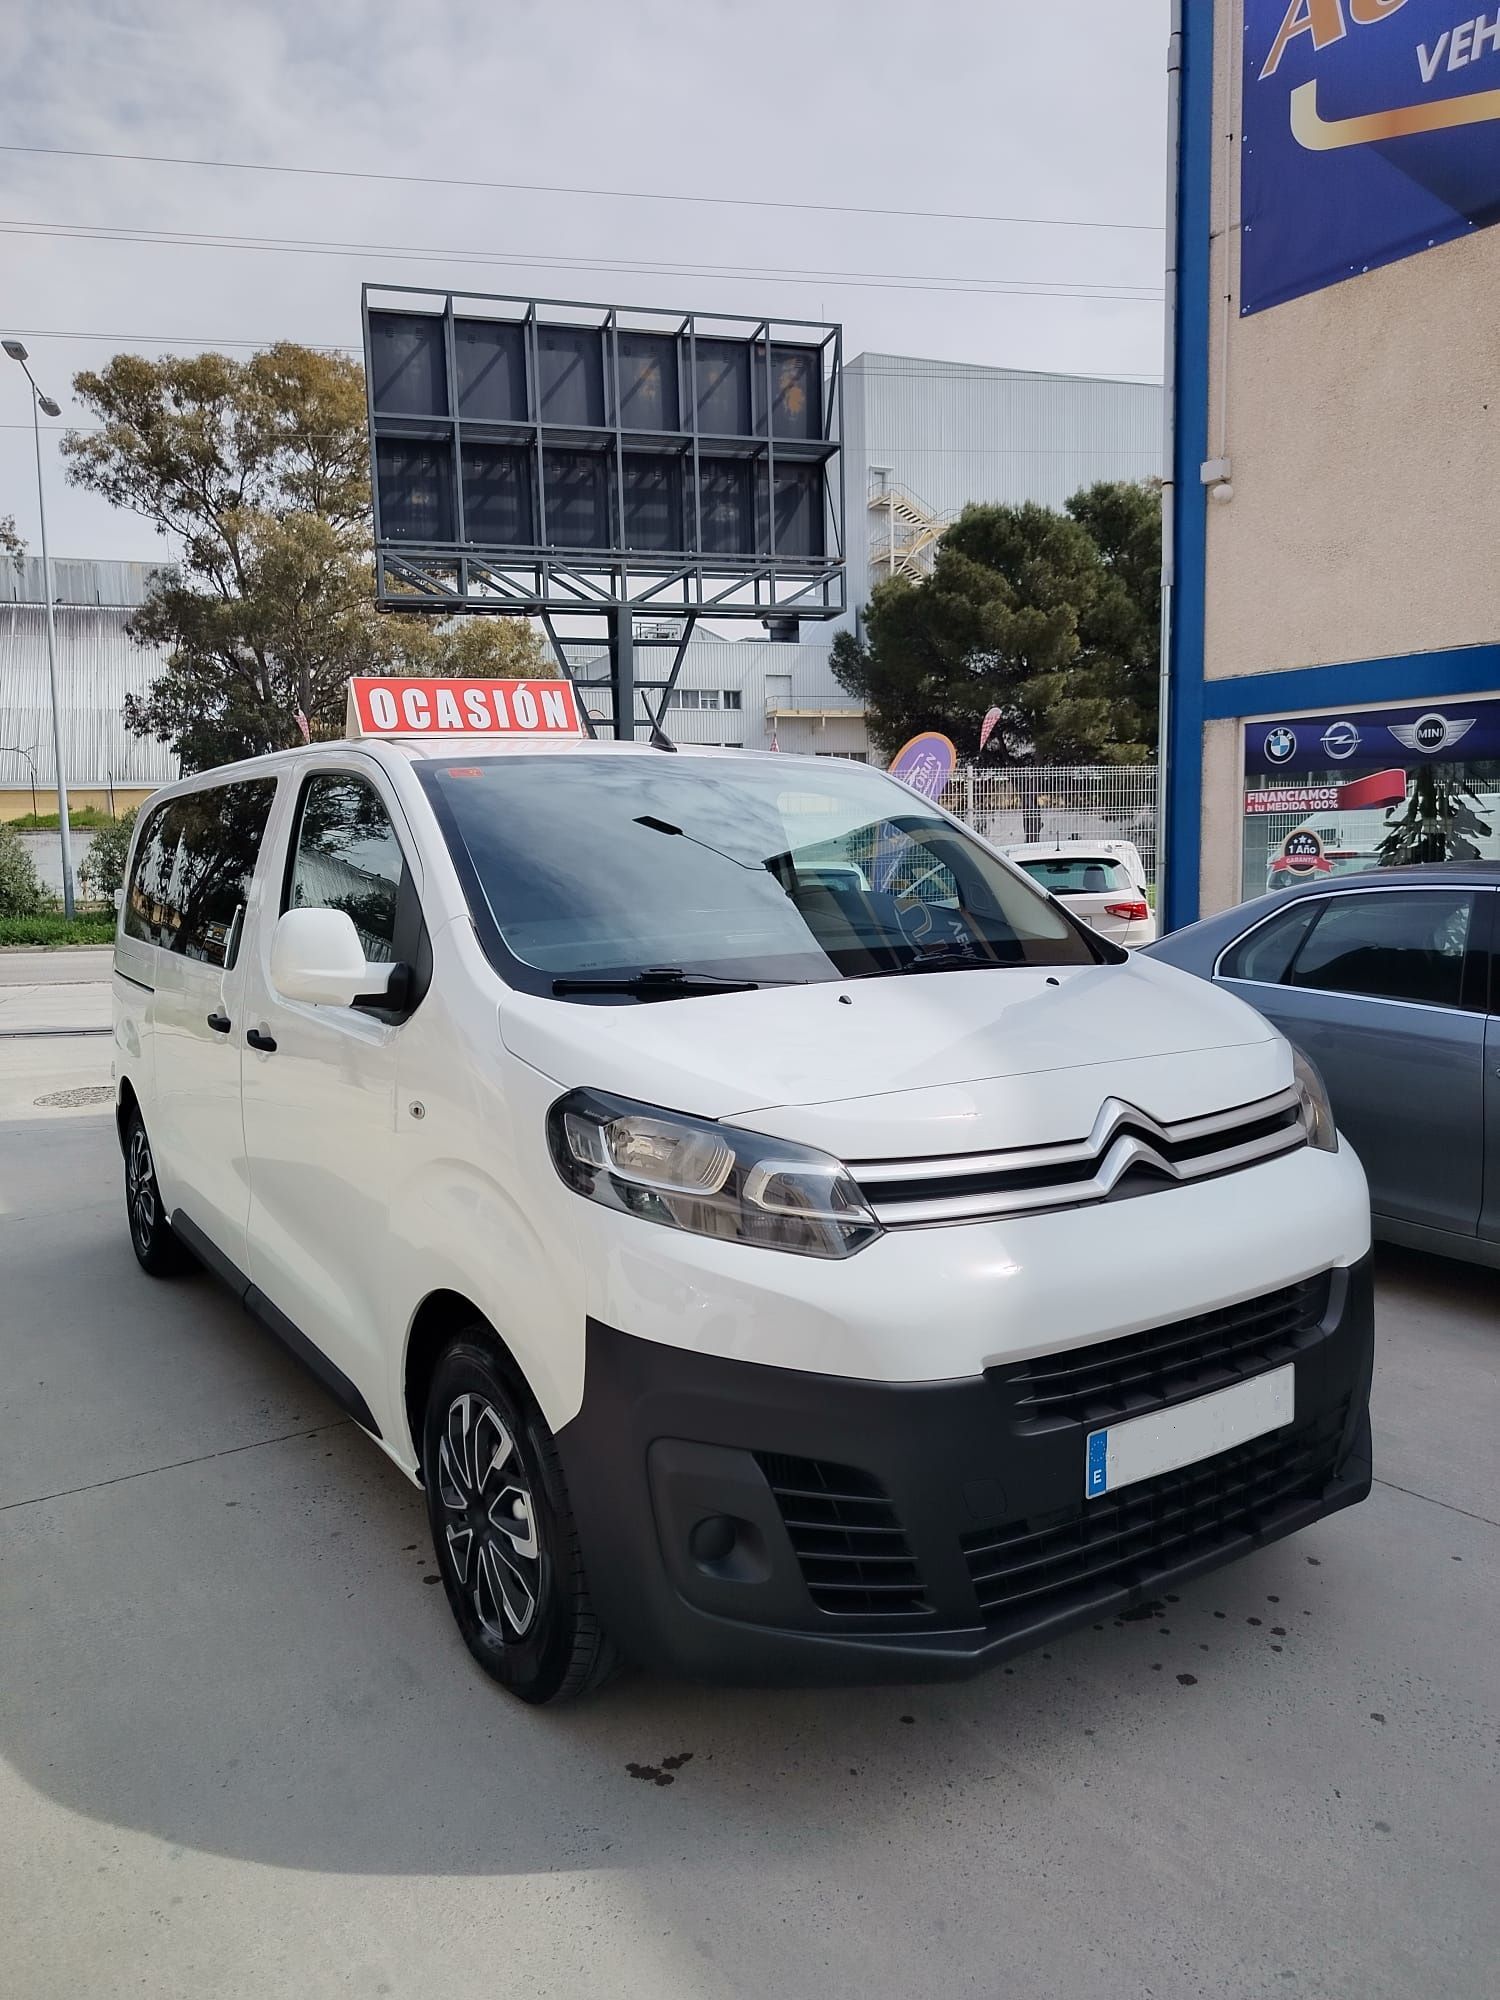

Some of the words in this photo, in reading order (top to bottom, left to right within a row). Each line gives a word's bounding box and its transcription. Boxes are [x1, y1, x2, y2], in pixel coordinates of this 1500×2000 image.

[369, 683, 568, 729] OCASIÓN
[1418, 727, 1443, 739] MINI
[1247, 788, 1338, 803] FINANCIAMOS
[1254, 803, 1264, 812] tu
[1267, 801, 1307, 811] MEDIDA
[1309, 799, 1338, 810] 100%
[1288, 845, 1294, 854] 1
[1296, 844, 1317, 854] Año
[1094, 1469, 1102, 1484] E
